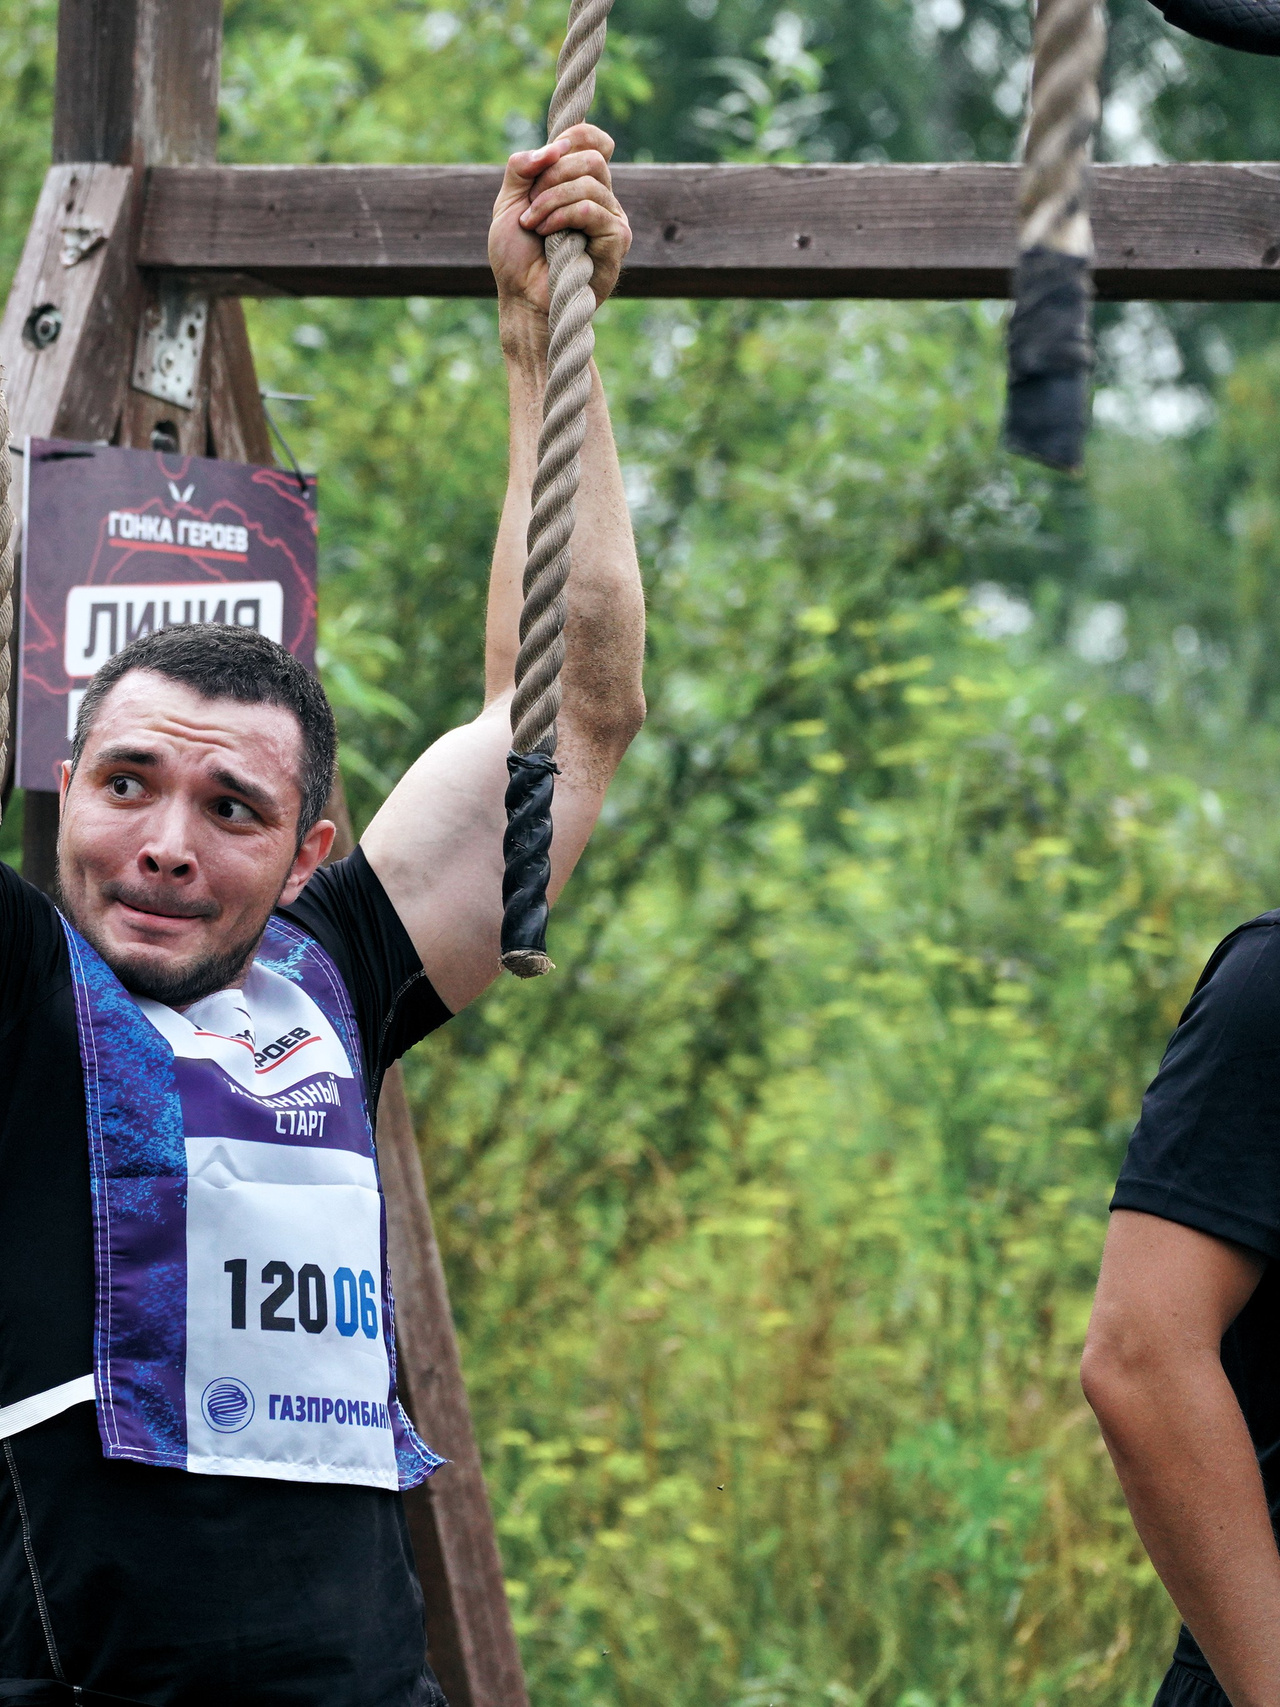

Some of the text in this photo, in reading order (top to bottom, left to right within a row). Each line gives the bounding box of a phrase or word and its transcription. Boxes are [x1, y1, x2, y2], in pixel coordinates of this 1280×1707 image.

[108, 510, 249, 552] ГОНКА ГЕРОЕВ
[254, 1027, 311, 1068] РОЕВ
[275, 1110, 327, 1137] СТАРТ
[224, 1258, 379, 1340] 12006
